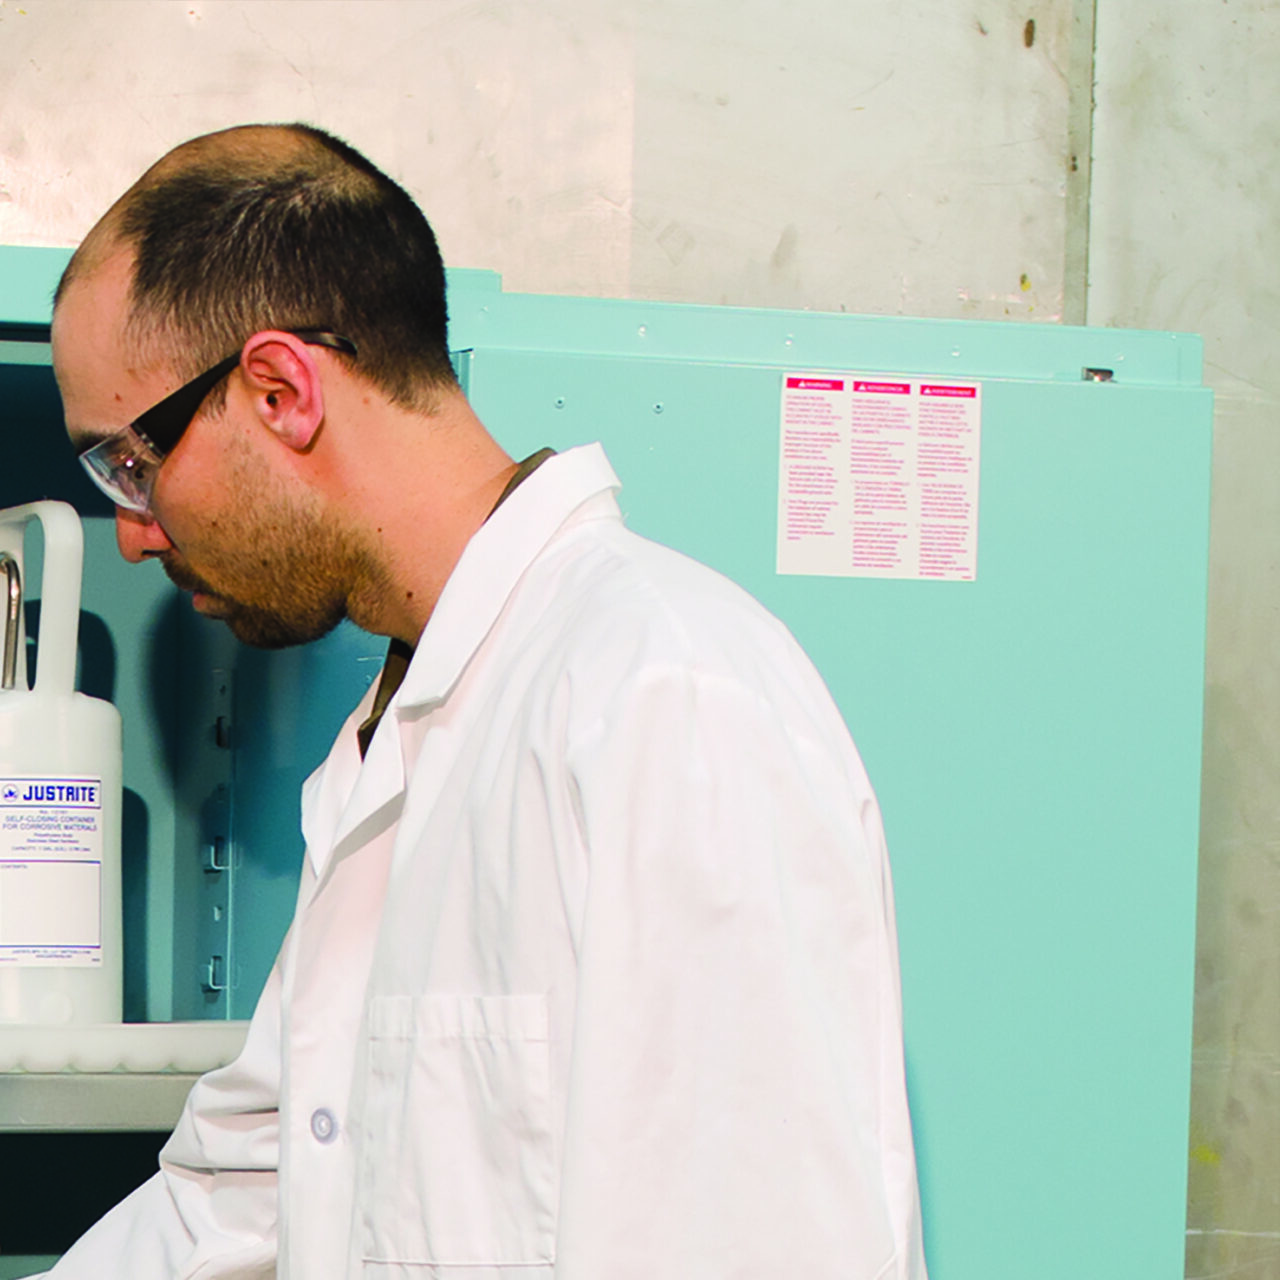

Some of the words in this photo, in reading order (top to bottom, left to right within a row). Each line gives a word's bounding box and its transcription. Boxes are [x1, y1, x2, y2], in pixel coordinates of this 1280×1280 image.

[5, 815, 58, 823] SELF-CLOSING
[60, 815, 95, 823] CONTAINER
[63, 824, 97, 832] MATERIALS
